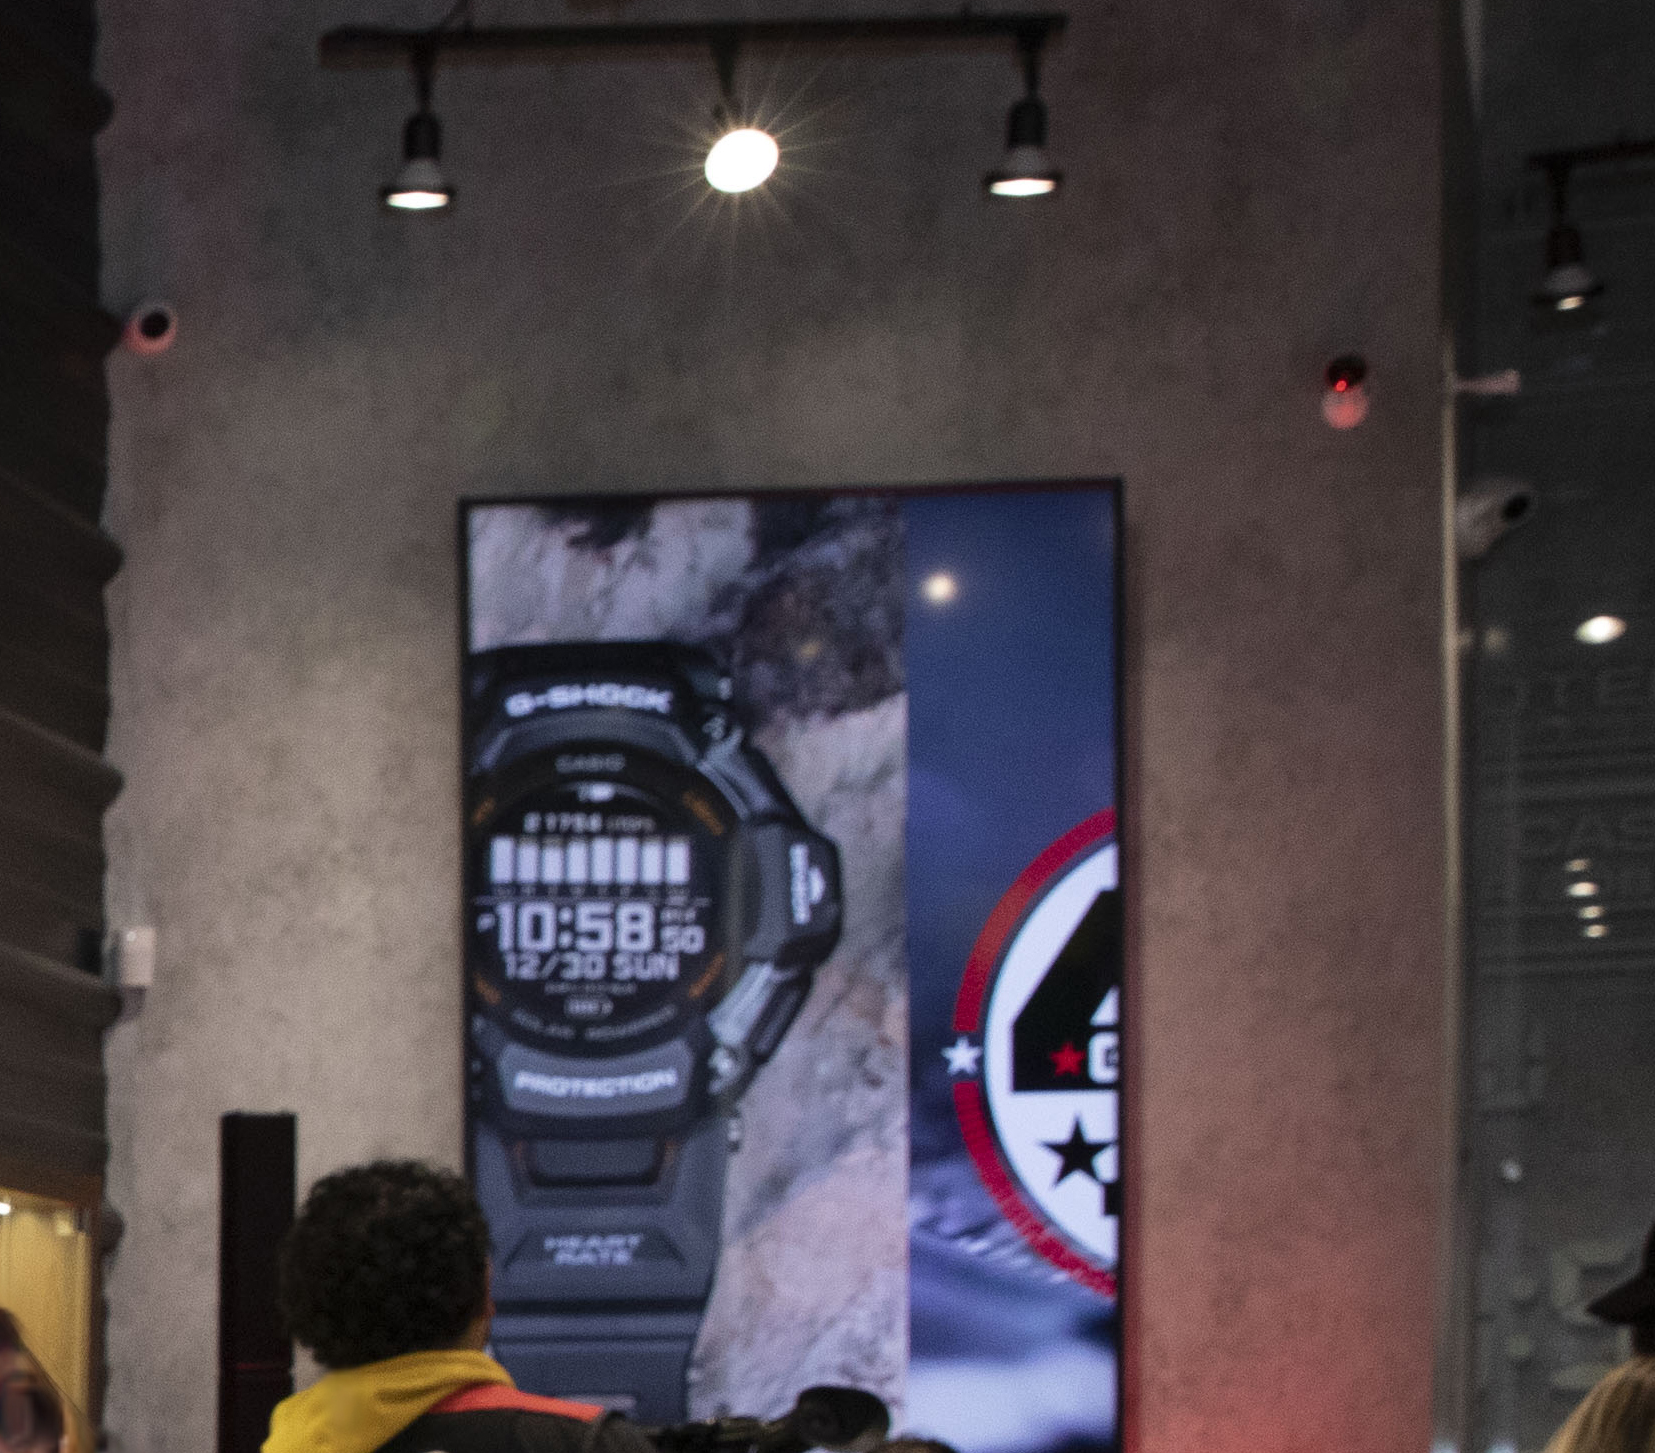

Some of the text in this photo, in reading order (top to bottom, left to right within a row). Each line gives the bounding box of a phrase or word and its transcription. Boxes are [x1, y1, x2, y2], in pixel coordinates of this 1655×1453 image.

[504, 682, 674, 717] G-SHOCK
[496, 901, 656, 952] 10:58
[515, 1068, 678, 1098] PROTECTION
[554, 1249, 632, 1267] RATE
